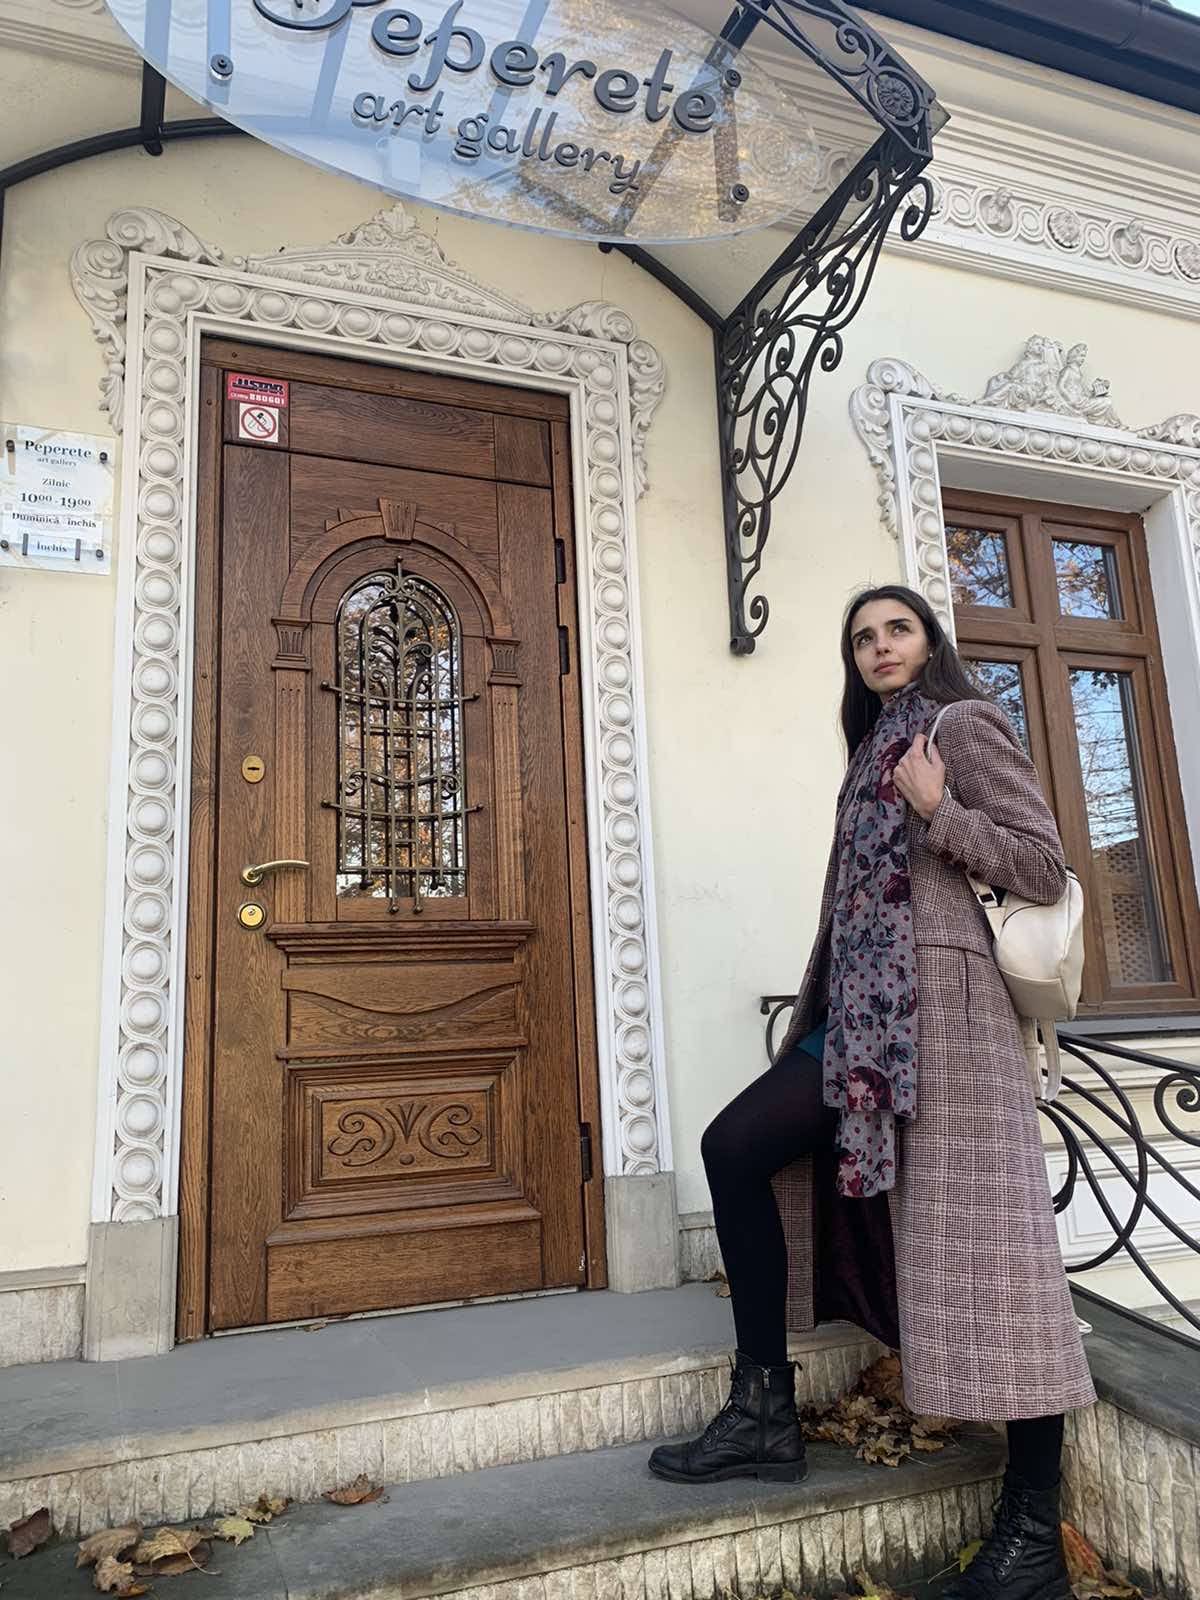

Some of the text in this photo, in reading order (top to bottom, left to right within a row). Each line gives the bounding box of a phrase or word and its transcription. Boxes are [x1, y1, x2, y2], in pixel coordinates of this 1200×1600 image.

[352, 91, 641, 194] art gallery
[25, 440, 92, 458] Peperete
[50, 458, 77, 467] gallery
[42, 477, 71, 488] Zilnic
